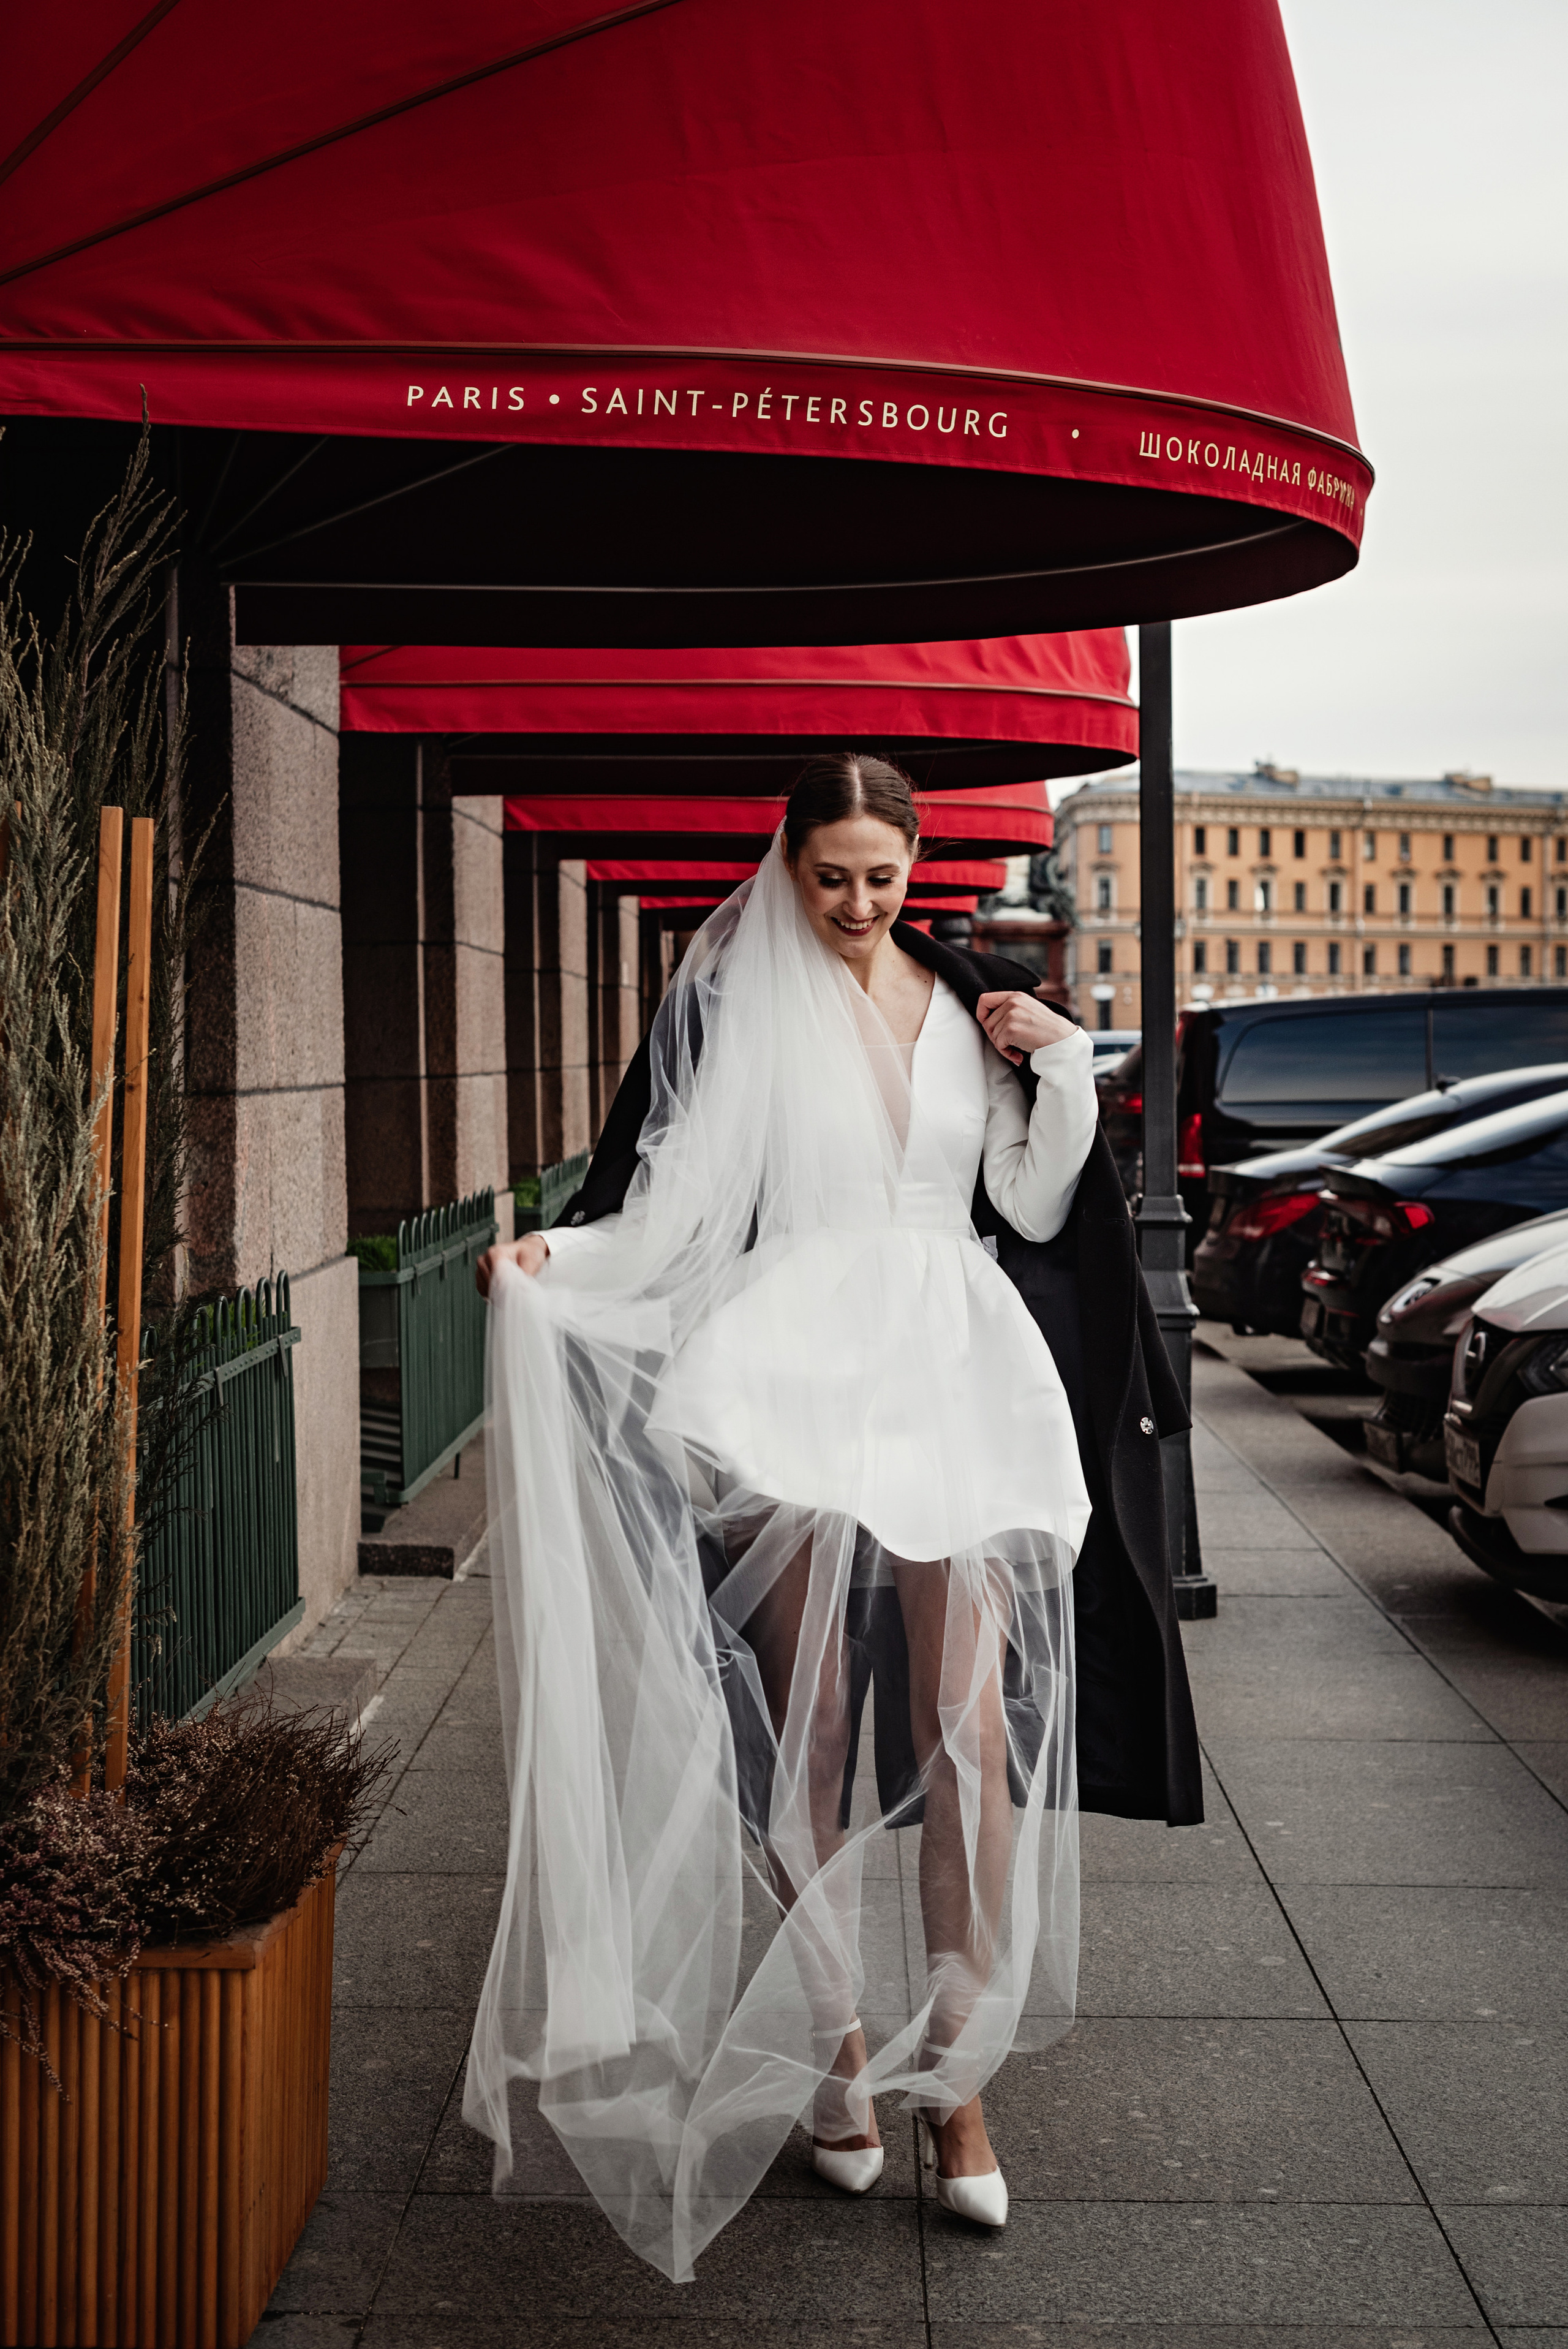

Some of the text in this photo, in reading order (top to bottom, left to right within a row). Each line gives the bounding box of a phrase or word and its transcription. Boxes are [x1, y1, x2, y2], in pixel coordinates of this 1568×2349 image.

[407, 385, 1008, 438] PARIS SAINT-PÉTERSBOURG
[1139, 431, 1302, 486] ШОКОЛАДНАЯ
